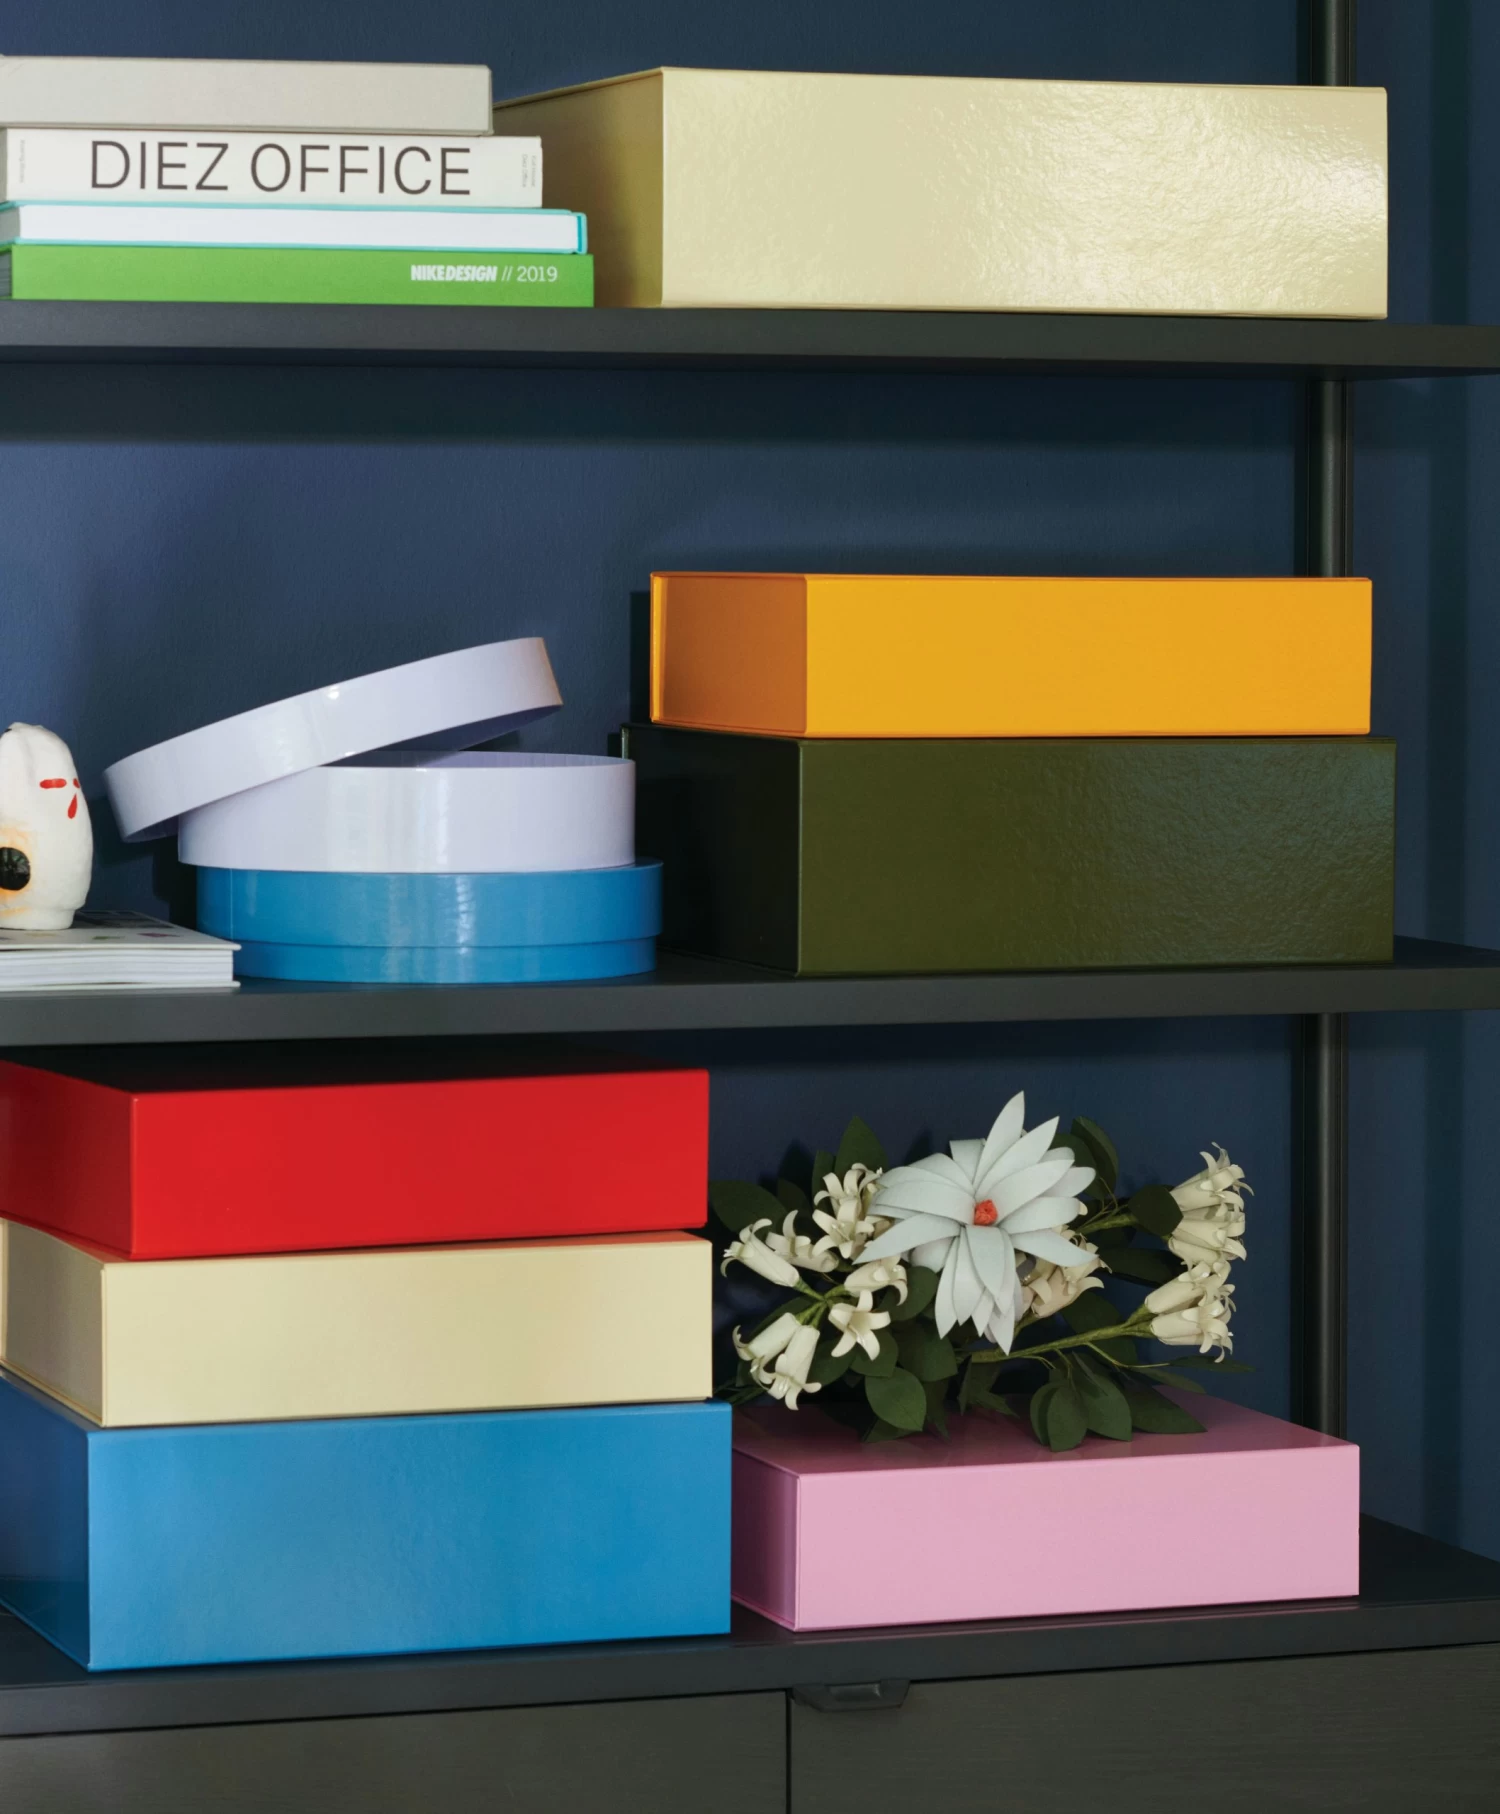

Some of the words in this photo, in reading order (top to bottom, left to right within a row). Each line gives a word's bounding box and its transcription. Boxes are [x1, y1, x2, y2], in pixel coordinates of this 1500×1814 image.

[91, 140, 230, 191] DIEZ
[251, 143, 470, 195] OFFICE
[517, 266, 558, 282] 2019
